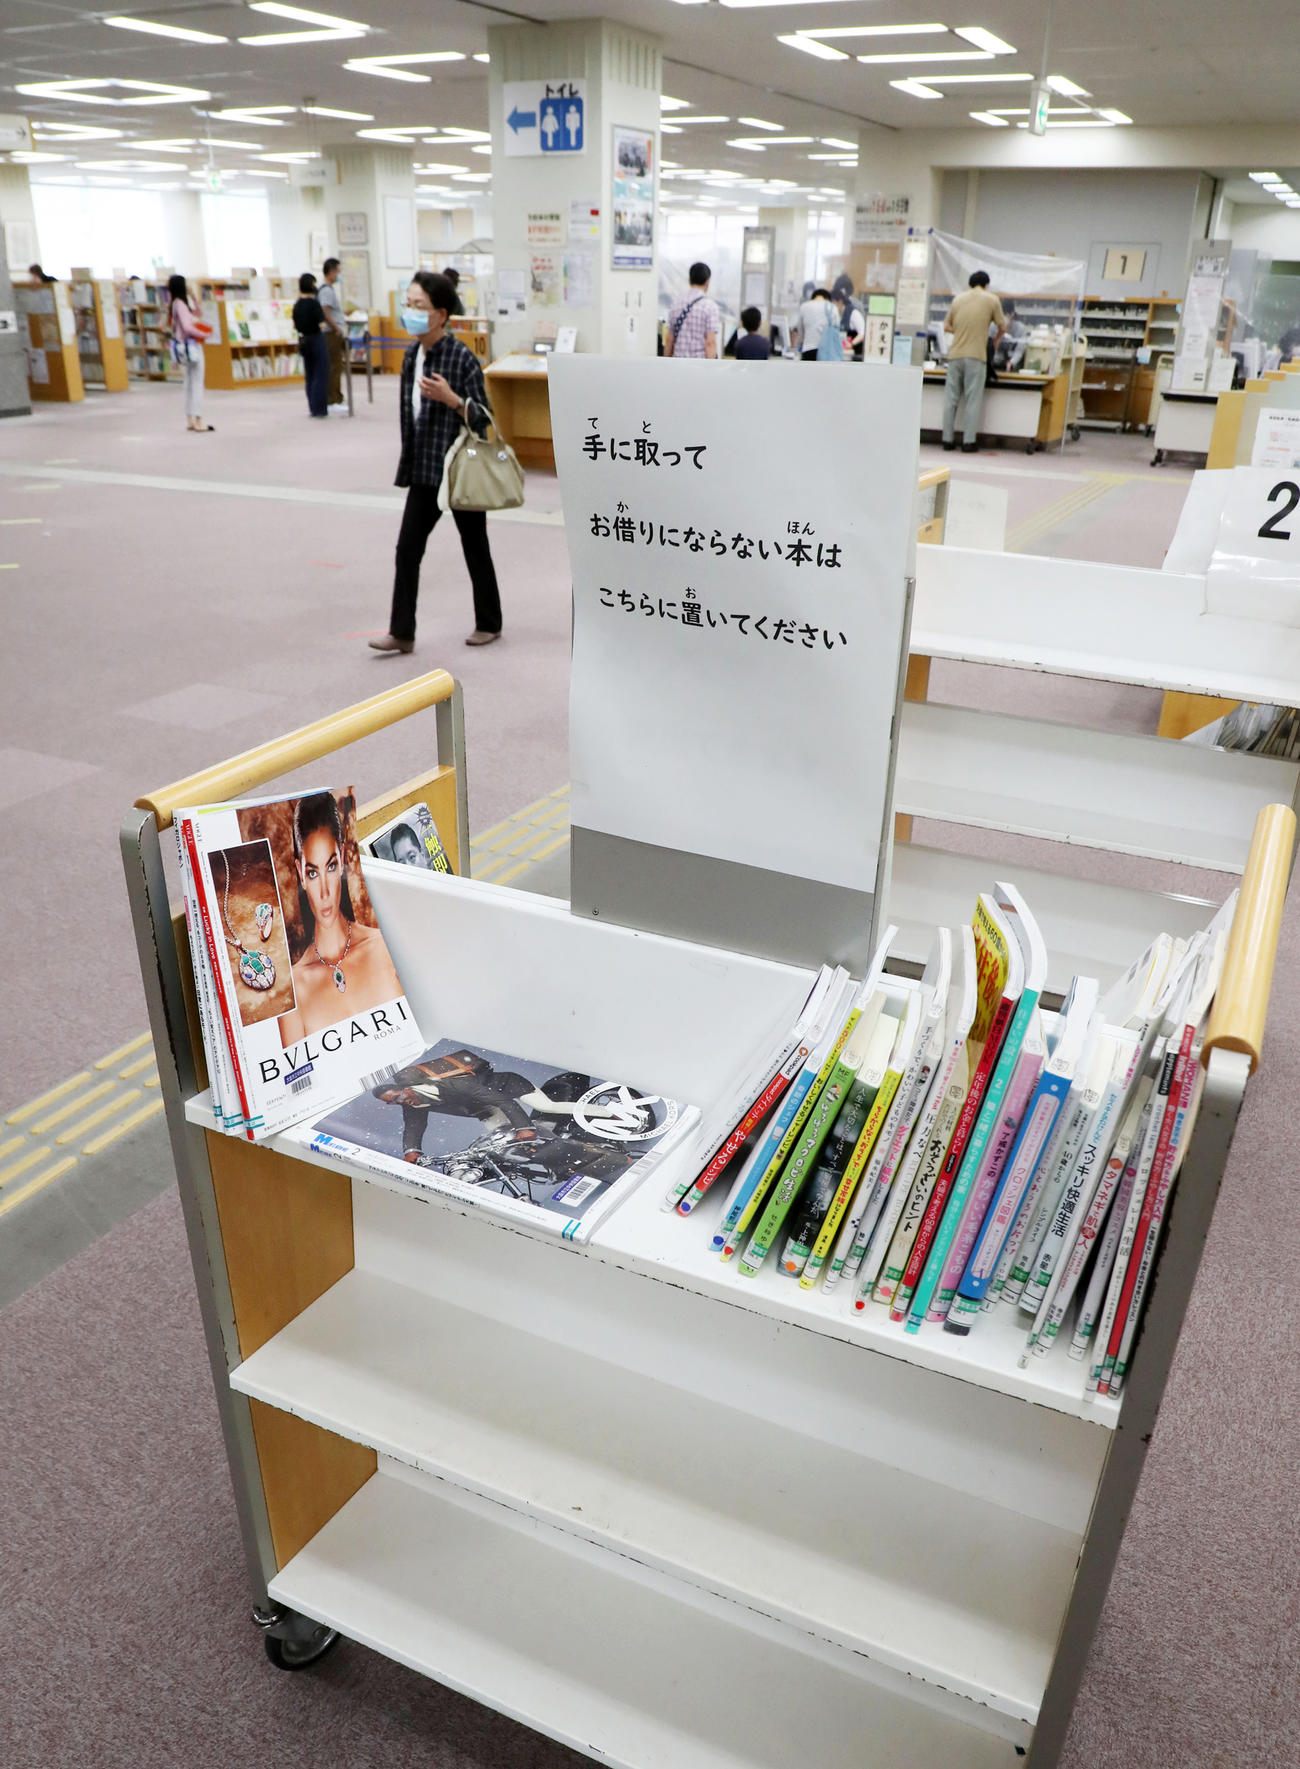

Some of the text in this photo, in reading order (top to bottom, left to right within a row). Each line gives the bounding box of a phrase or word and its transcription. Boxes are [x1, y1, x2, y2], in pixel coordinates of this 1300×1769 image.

[545, 83, 579, 98] トイレ
[587, 417, 599, 430] て
[642, 420, 652, 434] と
[582, 434, 707, 470] 手に取って
[616, 501, 629, 513] か
[787, 521, 816, 536] ほん
[1257, 481, 1300, 540] 2
[589, 513, 842, 568] お借りにならない本は
[685, 587, 697, 600] お
[599, 587, 847, 650] こちらに置いてください
[258, 1001, 409, 1084] BVLGARI
[373, 1025, 402, 1042] ROMA
[786, 1055, 802, 1076] cookpad
[951, 1072, 984, 1154] 定年後のお金と暮らし
[703, 1130, 746, 1185] やせるレシピ
[779, 1103, 830, 1203] ゆるゆるマクロビ生活
[903, 1139, 946, 1232] おそうざいのヒント
[1050, 1143, 1099, 1239] スッキリ快適生活
